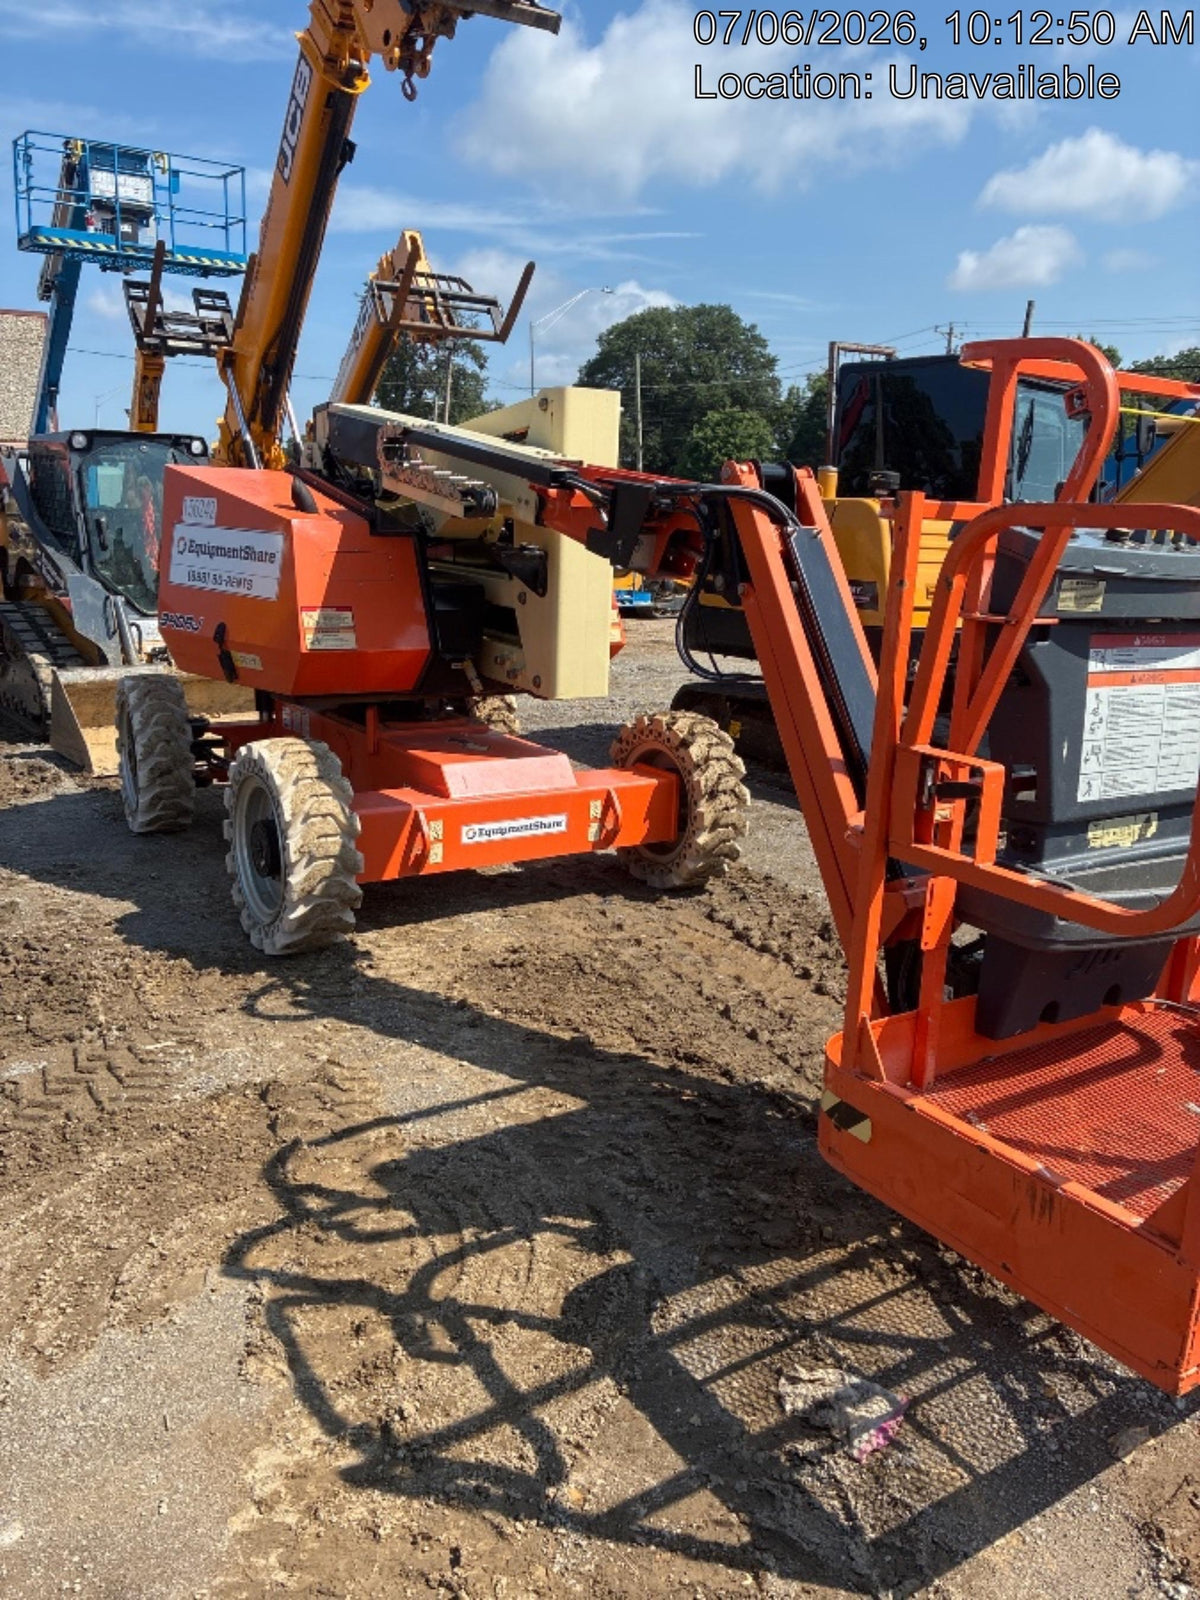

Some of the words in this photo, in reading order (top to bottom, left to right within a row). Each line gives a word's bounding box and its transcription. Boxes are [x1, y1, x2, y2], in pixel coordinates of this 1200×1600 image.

[281, 57, 312, 181] JCB
[188, 538, 277, 564] EquipmentShare
[477, 818, 565, 837] EquipmentShare
